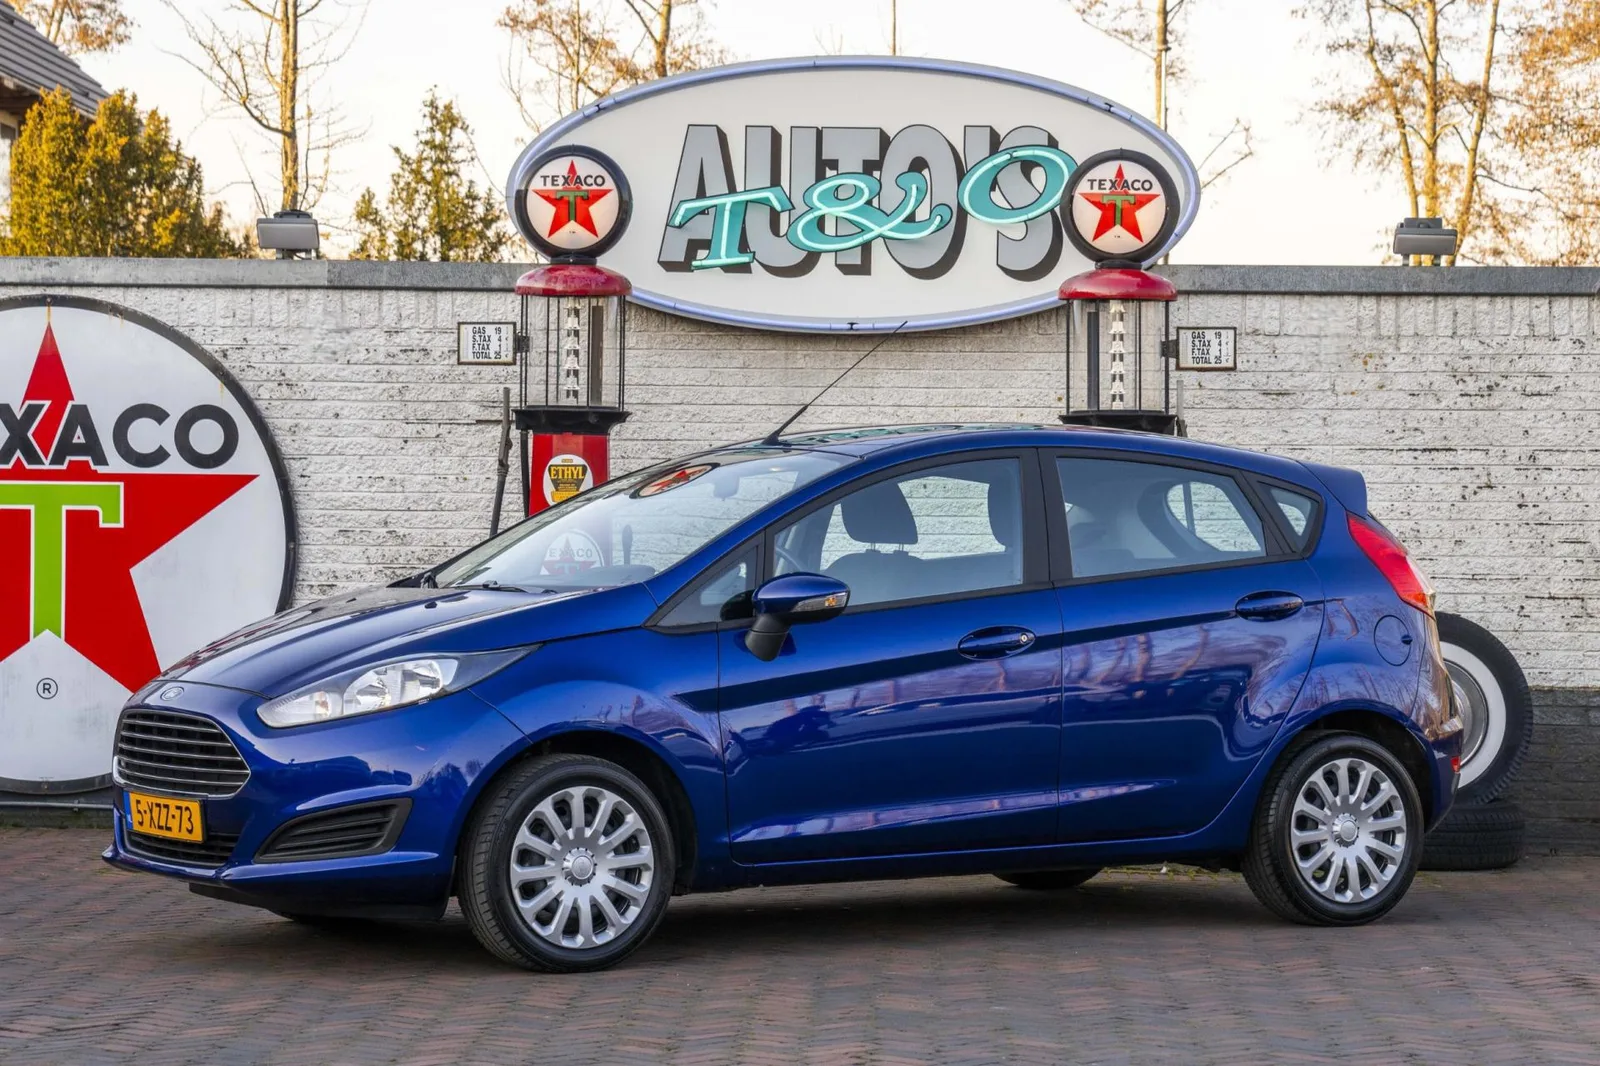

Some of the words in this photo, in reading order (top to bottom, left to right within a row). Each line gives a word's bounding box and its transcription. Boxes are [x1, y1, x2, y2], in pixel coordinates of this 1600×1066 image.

[540, 174, 606, 187] TEXACO
[1087, 178, 1154, 192] TEXACO
[556, 191, 588, 221] T
[657, 124, 1063, 282] AUTO'S
[1102, 195, 1136, 226] T
[472, 326, 486, 335] GAS
[494, 326, 502, 335] 19
[1191, 331, 1206, 340] GAS
[1214, 331, 1222, 340] 19
[472, 335, 492, 343] S.TAX
[497, 335, 502, 343] 4
[1191, 340, 1212, 348] S.TAX
[1217, 340, 1222, 348] 4
[472, 343, 491, 351] F.TAX
[1191, 348, 1210, 356] F.TAX
[472, 351, 492, 360] TOTAL
[494, 351, 502, 360] 25
[1191, 356, 1213, 365] TOTAL
[1214, 356, 1222, 365] 25
[0, 402, 239, 469] XACO
[551, 466, 585, 479] ETHYL
[548, 547, 593, 559] EXACO
[136, 799, 194, 835] 5-XZZ-73
